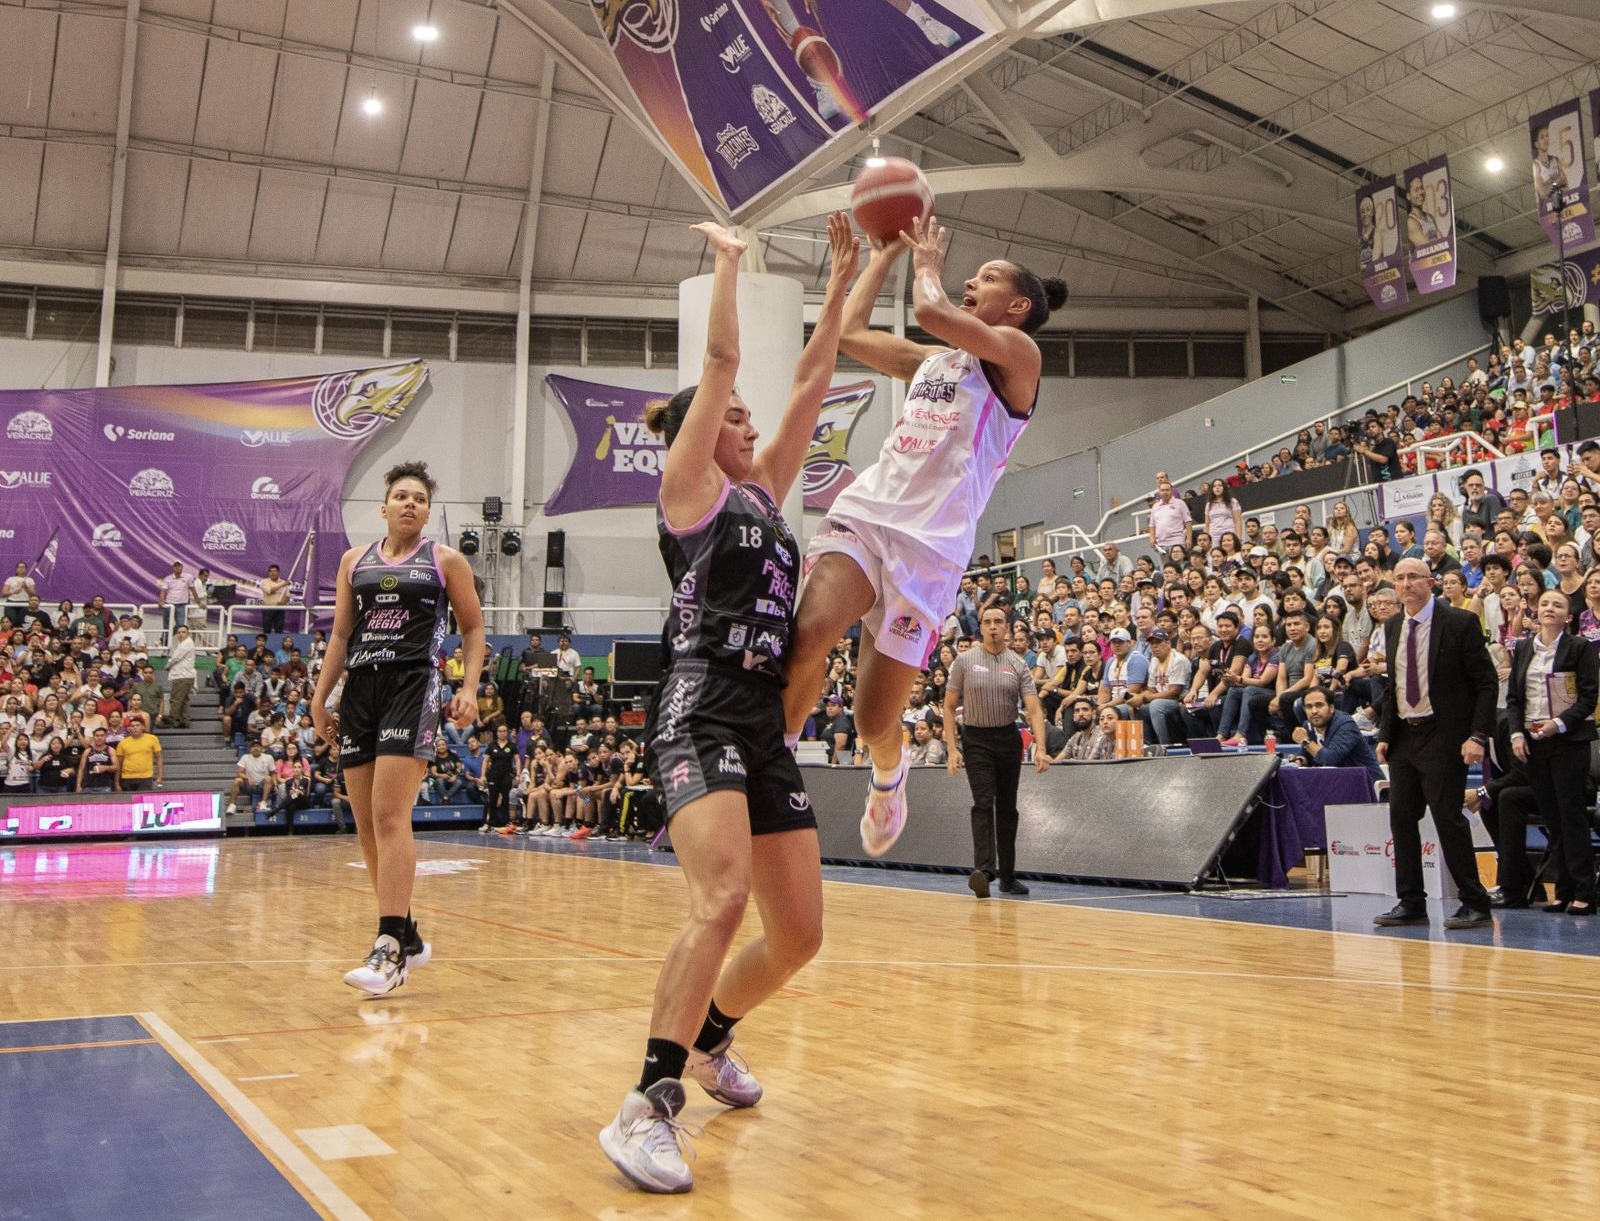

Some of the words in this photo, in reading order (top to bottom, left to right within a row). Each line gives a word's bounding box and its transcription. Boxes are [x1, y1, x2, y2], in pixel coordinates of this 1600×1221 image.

[7, 431, 53, 441] VERACRUZ
[127, 428, 175, 441] Soriana
[243, 430, 292, 443] VALUE
[614, 422, 667, 446] VA
[130, 489, 174, 498] VERACRUZ
[739, 526, 763, 549] 18
[202, 542, 247, 551] VERACRUZ
[368, 619, 402, 629] REGIA
